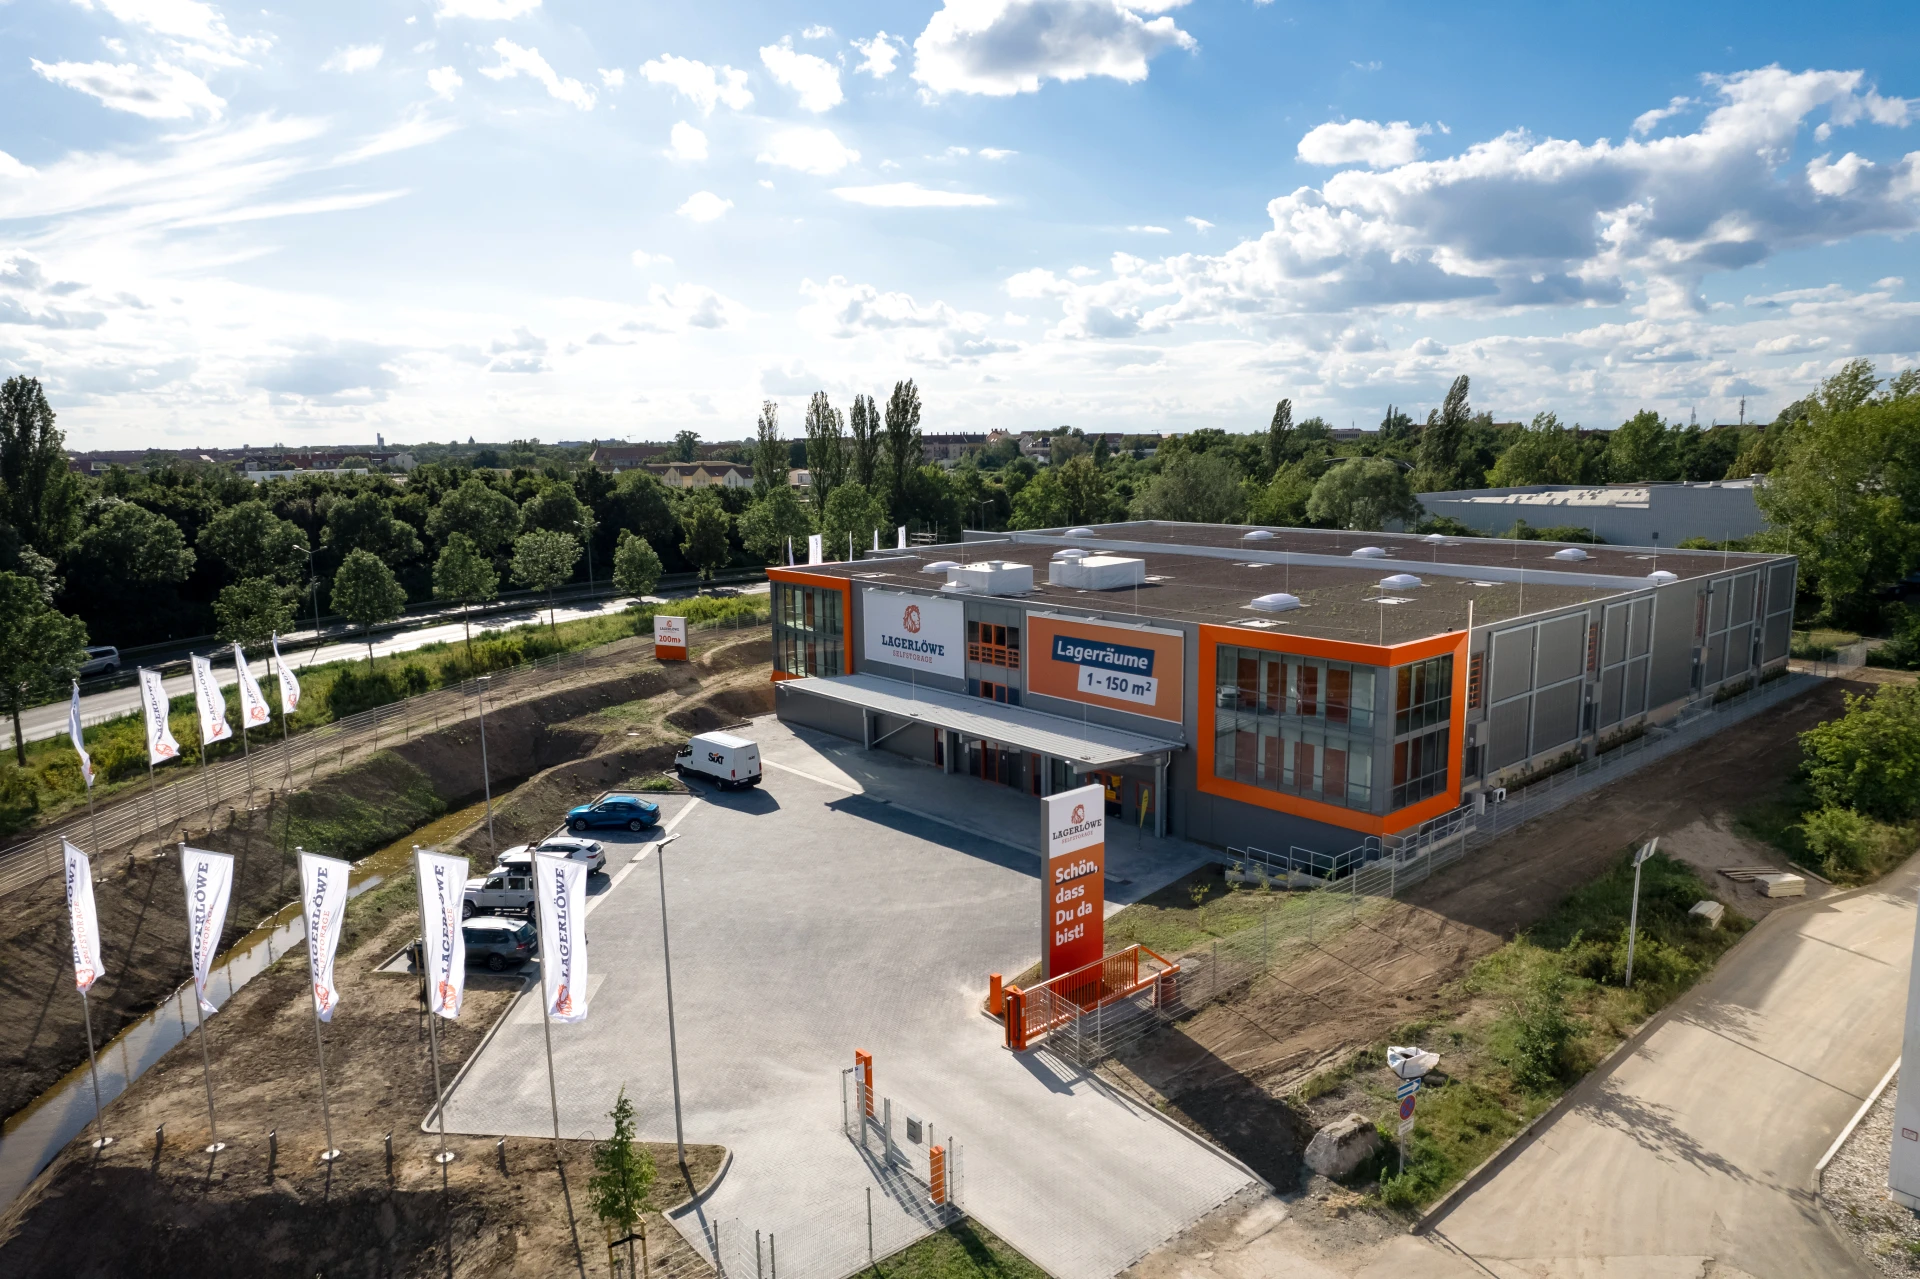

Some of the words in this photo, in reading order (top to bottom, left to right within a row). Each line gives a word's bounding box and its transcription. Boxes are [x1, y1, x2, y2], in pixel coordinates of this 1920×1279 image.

[659, 634, 678, 643] 200m
[881, 634, 945, 657] LAGERLÖWE
[892, 649, 933, 664] SELFSTORAGE
[1056, 640, 1149, 670] Lagerräume
[1087, 672, 1093, 686] 1
[1105, 675, 1129, 693] 150
[1052, 818, 1103, 841] LAGERLÖWE
[1061, 830, 1094, 845] SELFSTORAGE
[1055, 859, 1099, 884] Schön,
[1055, 884, 1085, 904] dass
[194, 862, 209, 971] LAGERLÖWE
[311, 866, 328, 979] LAGERLÖWE
[553, 867, 569, 978] LAGERLÖWE
[1055, 909, 1074, 926] Du
[1077, 900, 1093, 917] da
[1055, 922, 1085, 947] bist!
